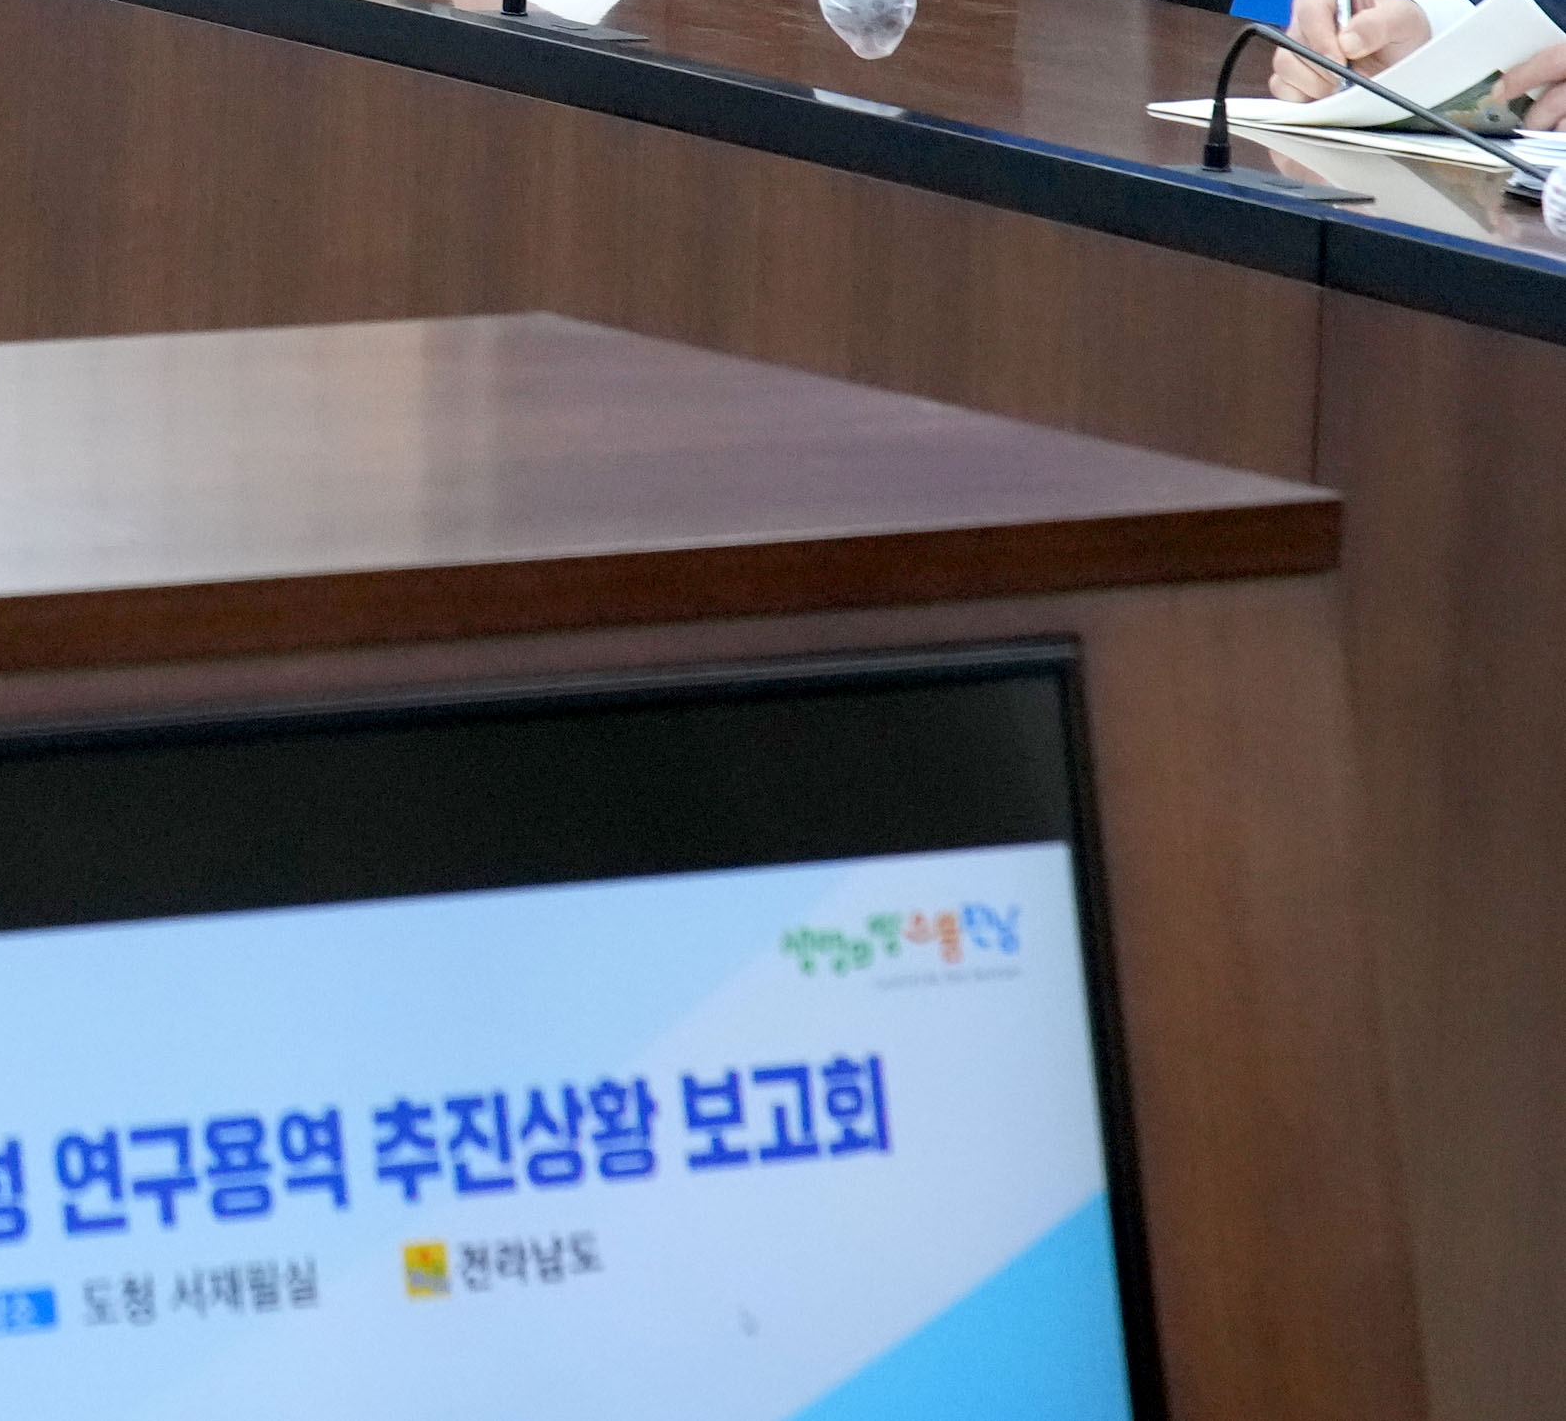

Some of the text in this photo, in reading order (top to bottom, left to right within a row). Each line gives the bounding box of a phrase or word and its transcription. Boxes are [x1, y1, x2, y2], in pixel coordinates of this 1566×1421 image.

[54, 1105, 350, 1236] 연구용역
[372, 1073, 659, 1204] 추진상황
[680, 1052, 894, 1174] 보고회
[82, 1272, 158, 1327] 도청
[171, 1257, 321, 1319] 서재필실
[459, 1229, 604, 1295] 전라남도
